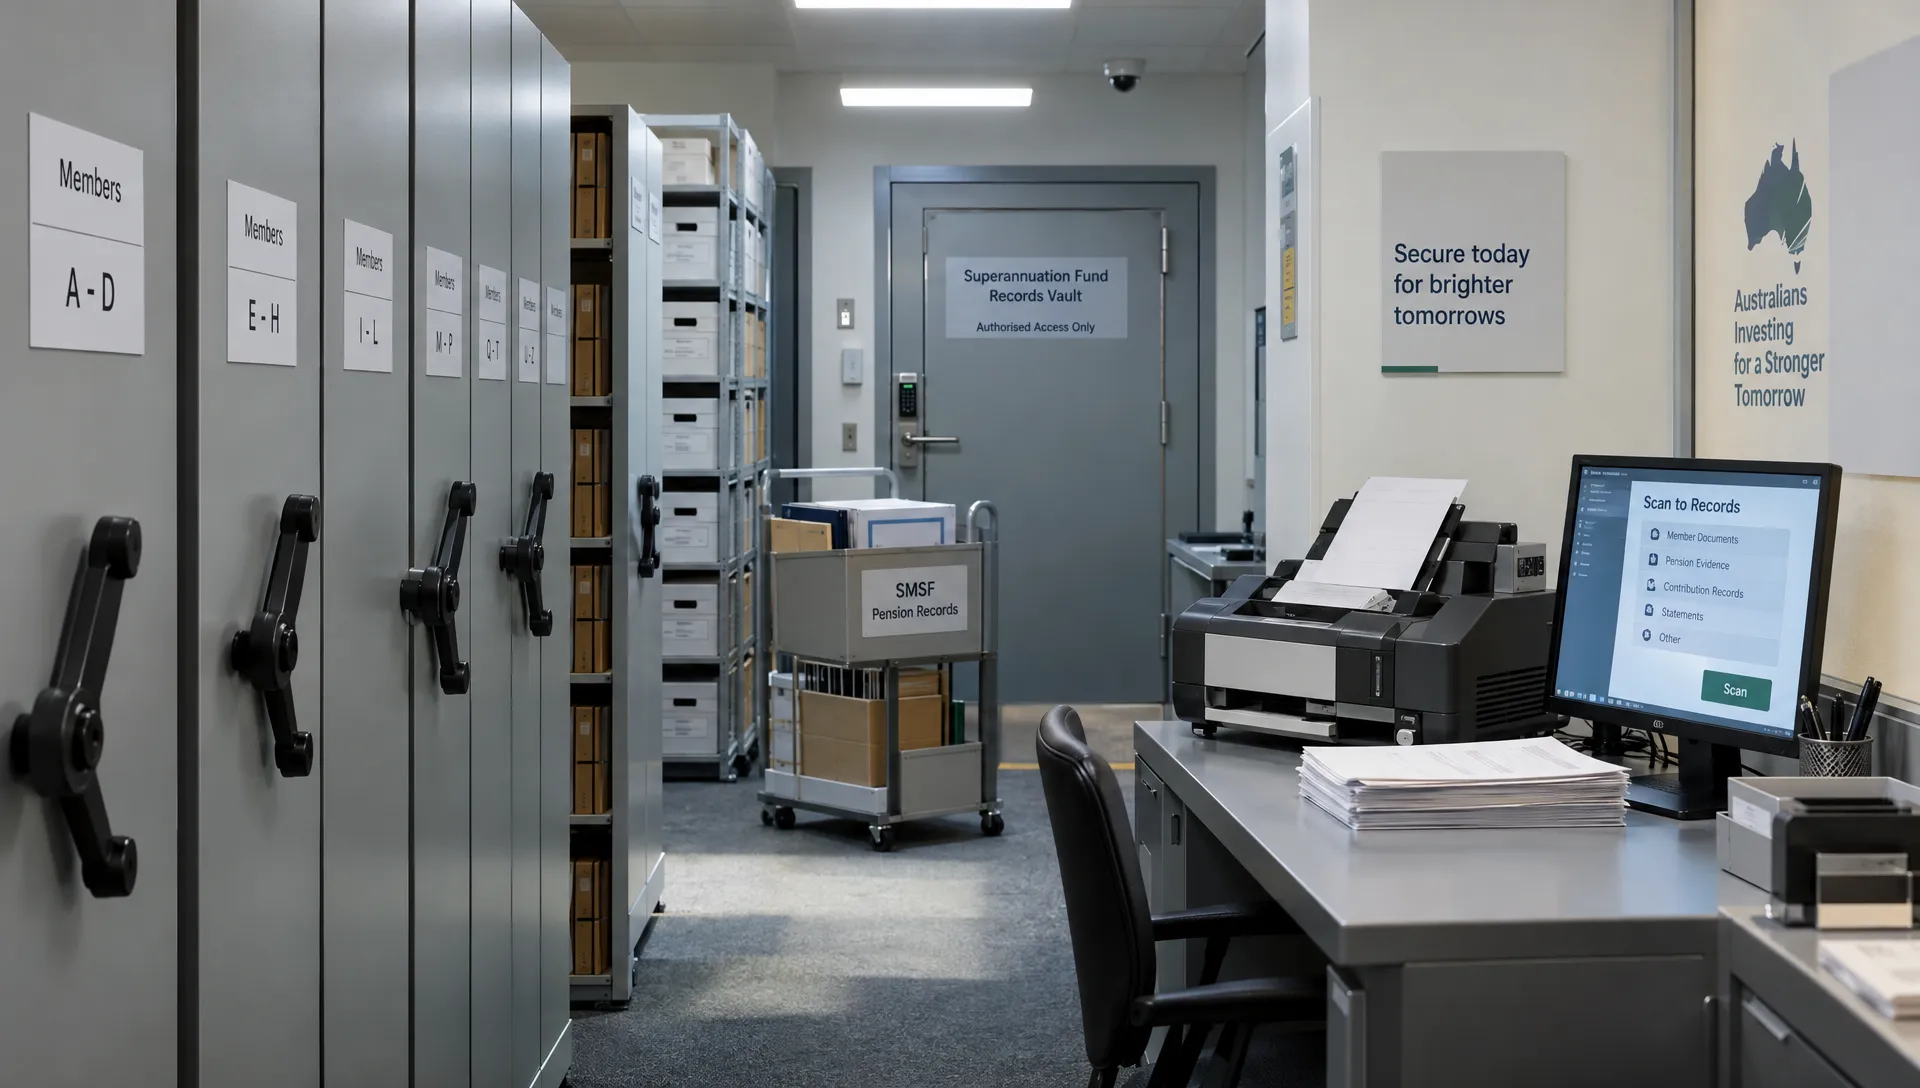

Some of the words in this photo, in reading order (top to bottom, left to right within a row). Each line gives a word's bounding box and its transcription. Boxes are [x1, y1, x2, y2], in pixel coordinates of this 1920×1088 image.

[60, 158, 121, 203] Members
[245, 214, 283, 246] Members
[357, 247, 383, 271] Members
[1395, 243, 1465, 263] Secure
[1472, 243, 1530, 268] today
[965, 269, 1070, 285] Superannuation
[1075, 269, 1108, 282] Fund
[1394, 273, 1423, 293] for
[1430, 274, 1513, 299] brighter
[990, 289, 1043, 302] Records
[1048, 289, 1082, 302] Vault
[1734, 283, 1807, 312] Australians
[1394, 307, 1505, 325] tomorrows
[977, 322, 1031, 332] Authorised
[1034, 322, 1069, 332] Access
[1072, 322, 1095, 334] Only
[1735, 317, 1793, 345] Investing
[1734, 352, 1751, 375] for
[1755, 357, 1761, 374] a
[1765, 350, 1825, 379] Stronger
[1734, 384, 1805, 407] Tomorrow
[1644, 496, 1671, 510] Scan
[1675, 498, 1687, 510] to
[1691, 498, 1740, 513] Records
[1667, 531, 1696, 541] Member
[1698, 533, 1738, 544] Documents
[1666, 556, 1694, 567] Pension
[1697, 559, 1729, 570] Evidence
[896, 581, 935, 598] SMSF
[1664, 582, 1709, 595] Contribution
[1712, 586, 1743, 598] Records
[873, 606, 913, 620] Pension
[917, 603, 958, 617] Records
[1662, 607, 1703, 621] Statements
[1659, 633, 1681, 644] Other
[1724, 683, 1747, 697] Scan
